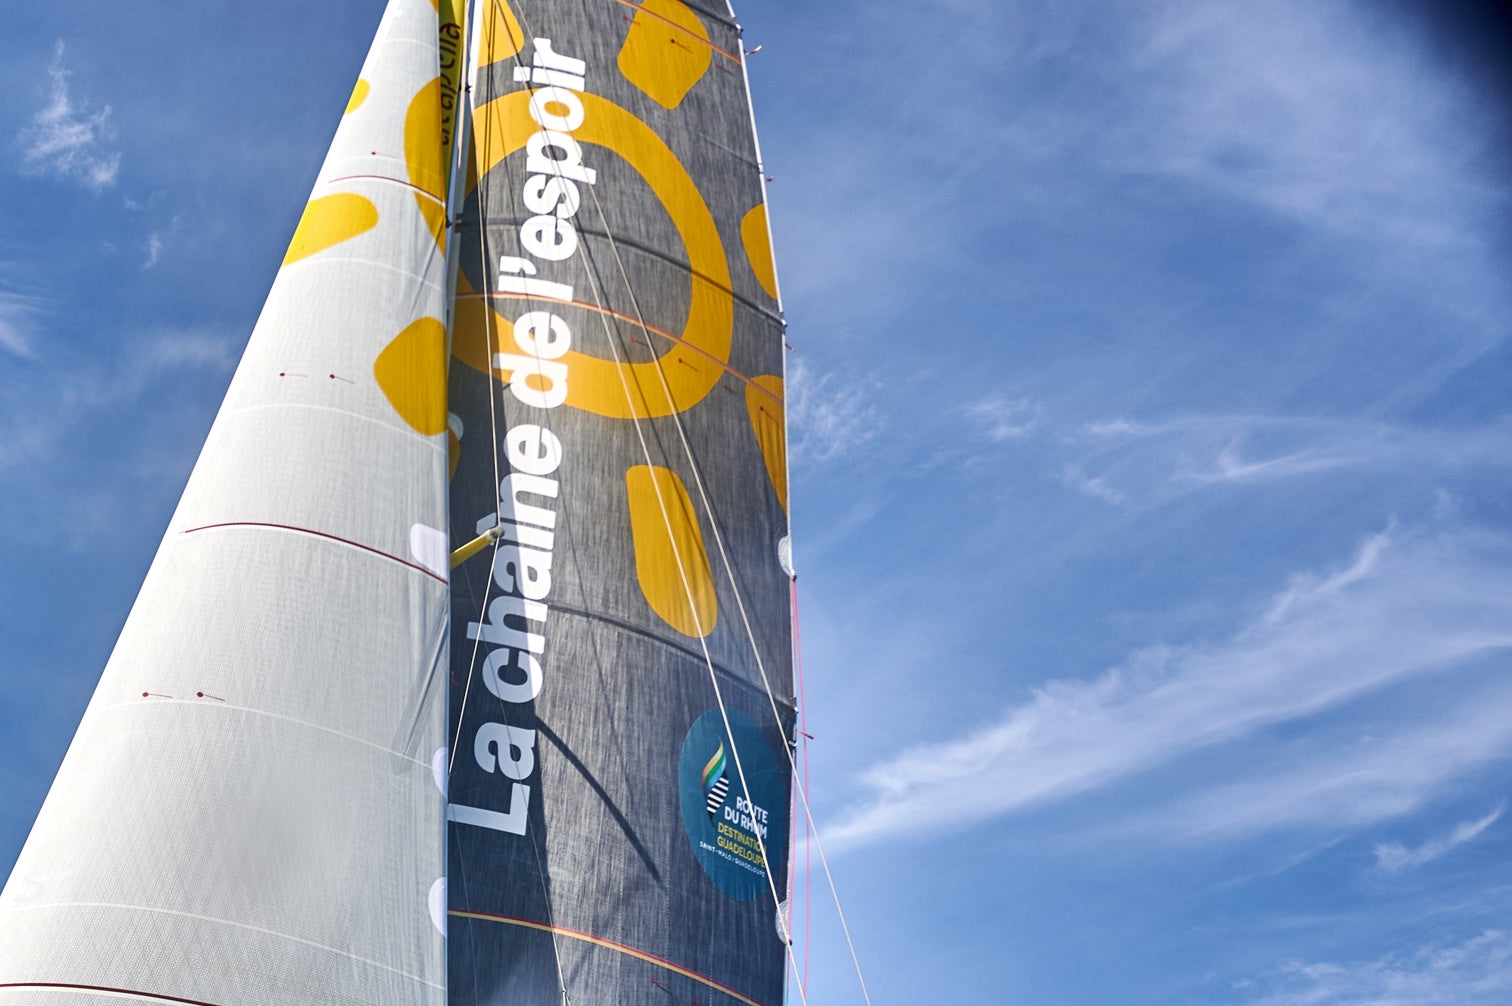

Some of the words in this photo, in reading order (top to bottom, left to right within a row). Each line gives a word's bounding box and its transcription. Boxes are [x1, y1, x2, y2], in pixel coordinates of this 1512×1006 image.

[498, 37, 597, 302] l'espoir
[493, 311, 572, 409] de
[448, 722, 536, 835] La
[724, 806, 740, 825] DU
[736, 796, 768, 824] ROUTE
